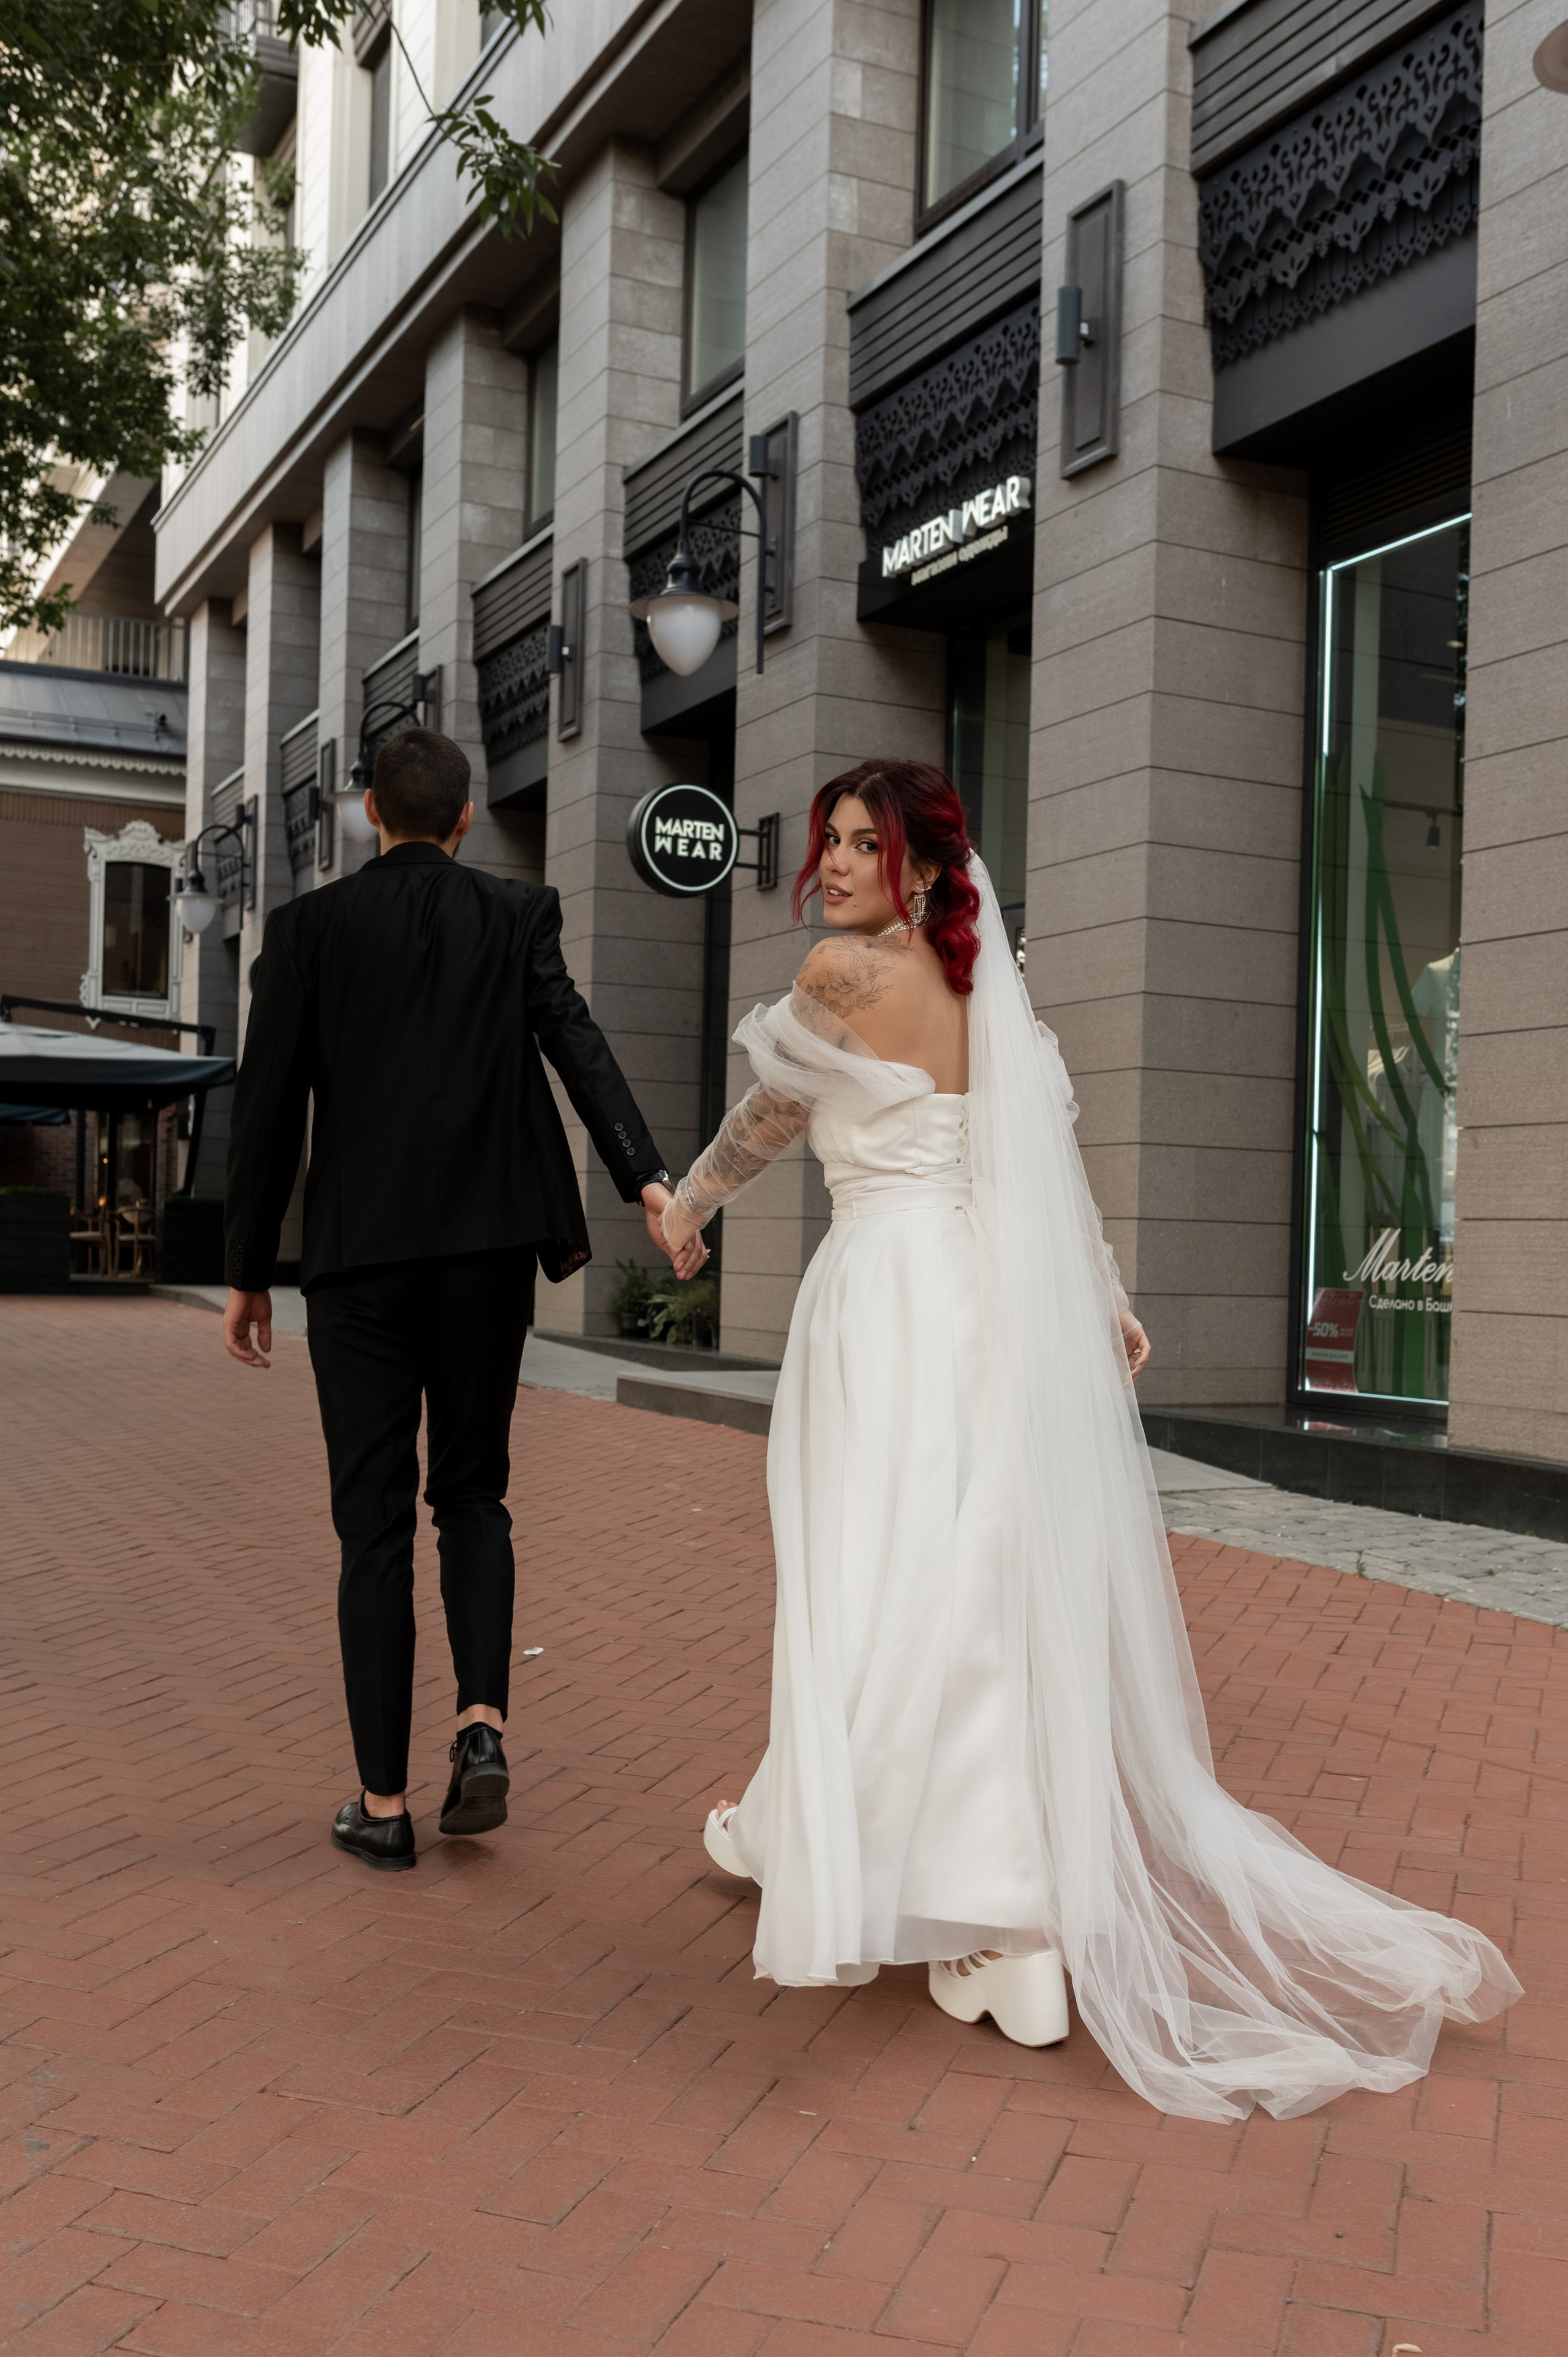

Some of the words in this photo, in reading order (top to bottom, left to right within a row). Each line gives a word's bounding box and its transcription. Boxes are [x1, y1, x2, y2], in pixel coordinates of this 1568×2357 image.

[882, 508, 957, 578] MARTEN
[962, 475, 1024, 535] WEAR
[654, 815, 725, 842] MARTEN
[654, 834, 723, 861] WEAR
[1343, 1227, 1454, 1283] Marten
[1368, 1294, 1415, 1311] Сделано
[1417, 1300, 1424, 1312] в
[1308, 1322, 1339, 1338] -50%
